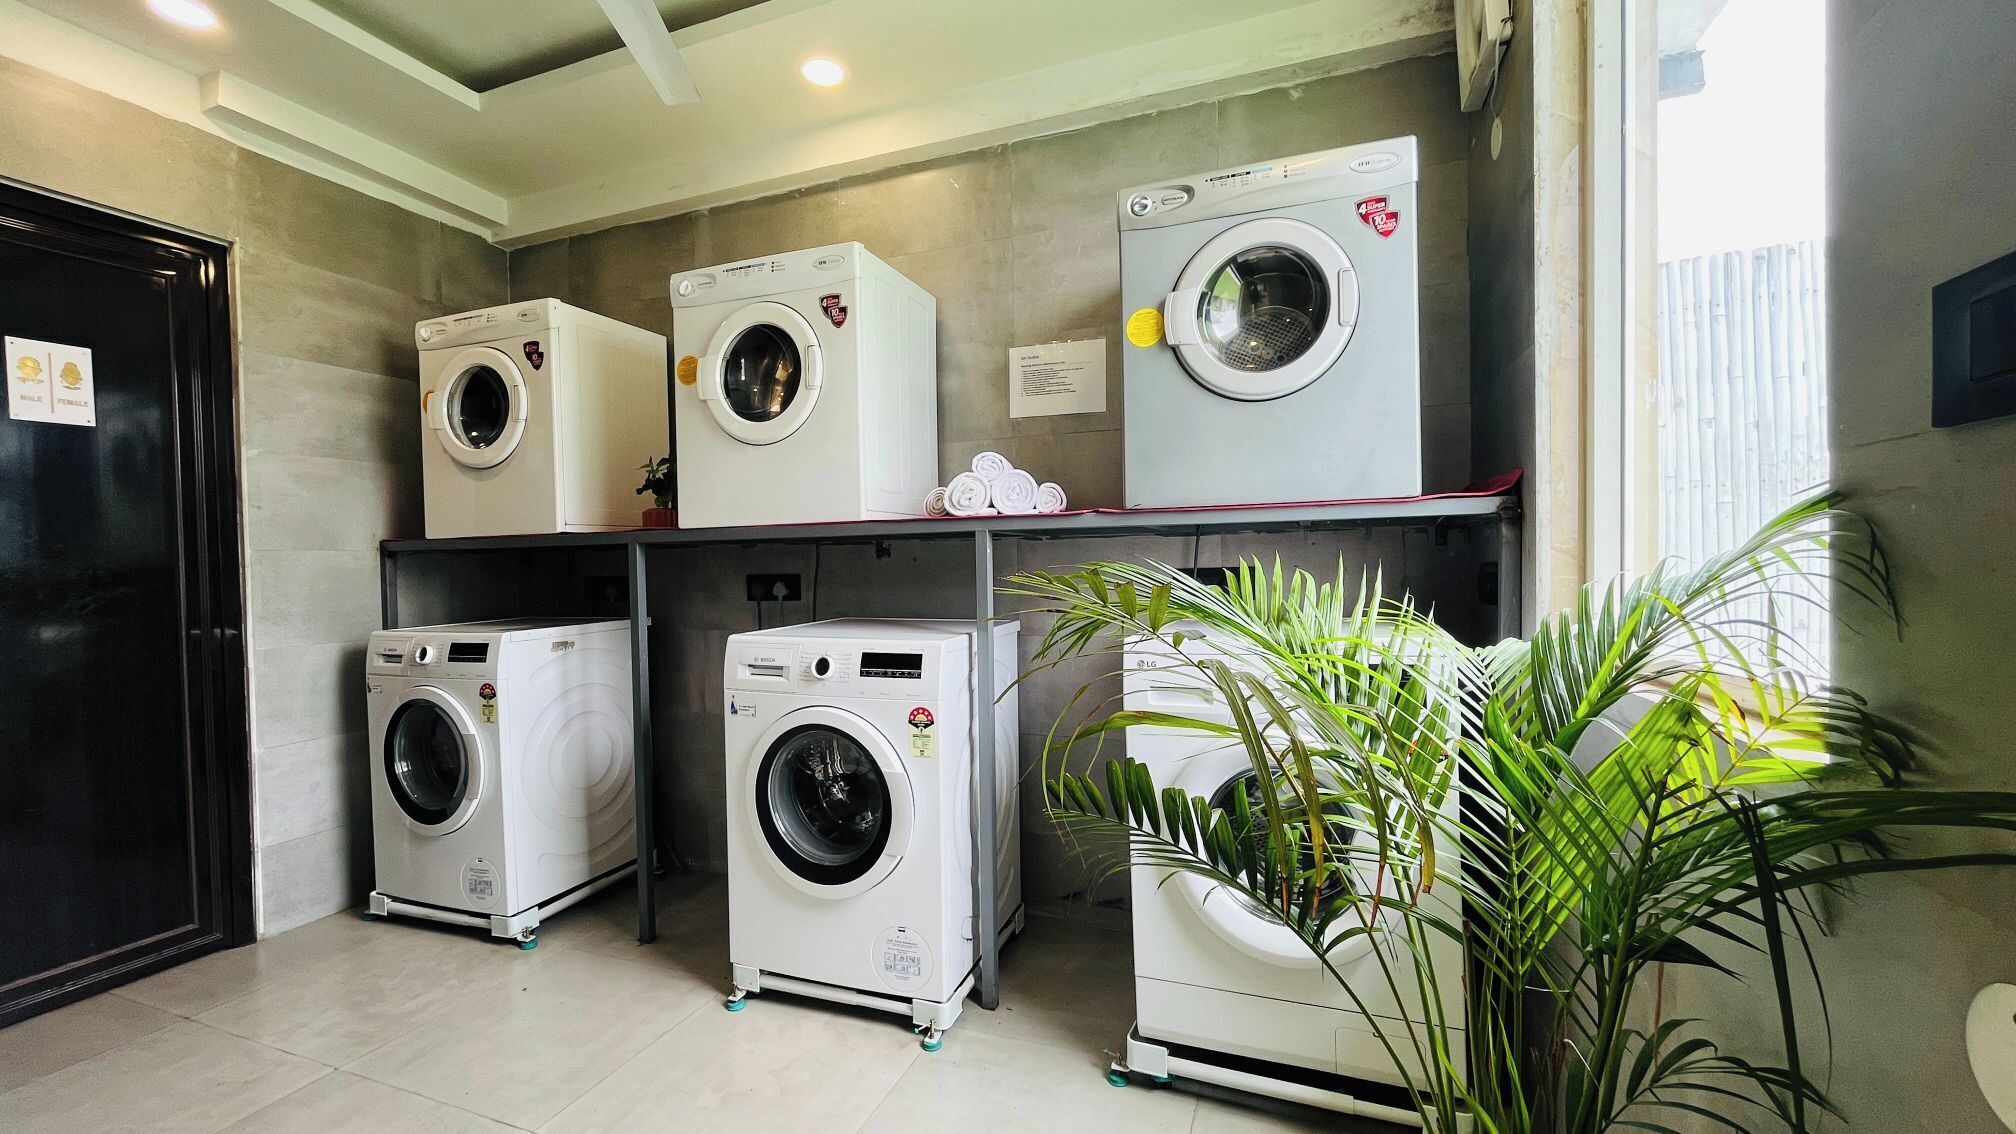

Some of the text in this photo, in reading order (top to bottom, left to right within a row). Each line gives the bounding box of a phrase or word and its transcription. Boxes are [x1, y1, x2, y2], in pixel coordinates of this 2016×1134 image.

[1359, 202, 1367, 215] 4
[1374, 214, 1387, 226] 10
[822, 298, 827, 308] 4
[831, 308, 839, 317] 10
